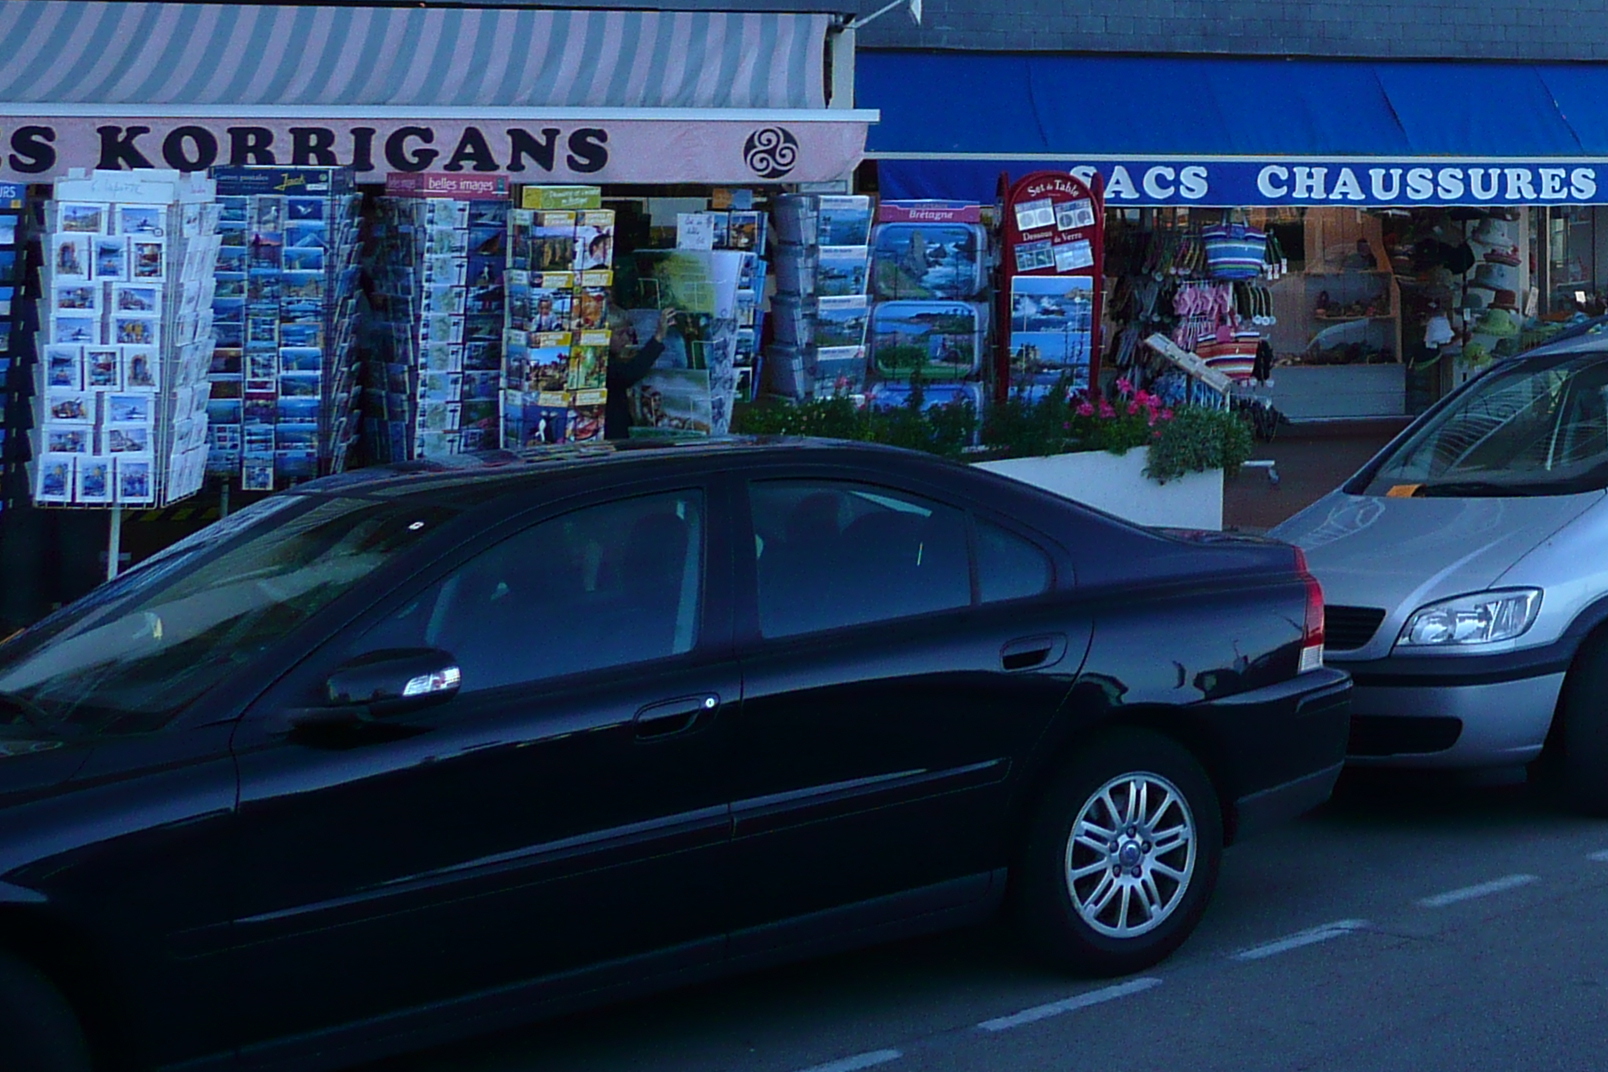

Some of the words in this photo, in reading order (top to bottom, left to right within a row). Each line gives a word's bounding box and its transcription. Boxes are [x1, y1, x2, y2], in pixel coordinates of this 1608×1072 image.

[95, 125, 609, 174] KORRIGANS
[428, 179, 457, 190] belles
[459, 179, 493, 192] images
[1027, 184, 1046, 197] Set
[1054, 179, 1079, 197] Table
[1257, 165, 1597, 200] CHAUSSURES
[909, 209, 953, 220] Bretagne
